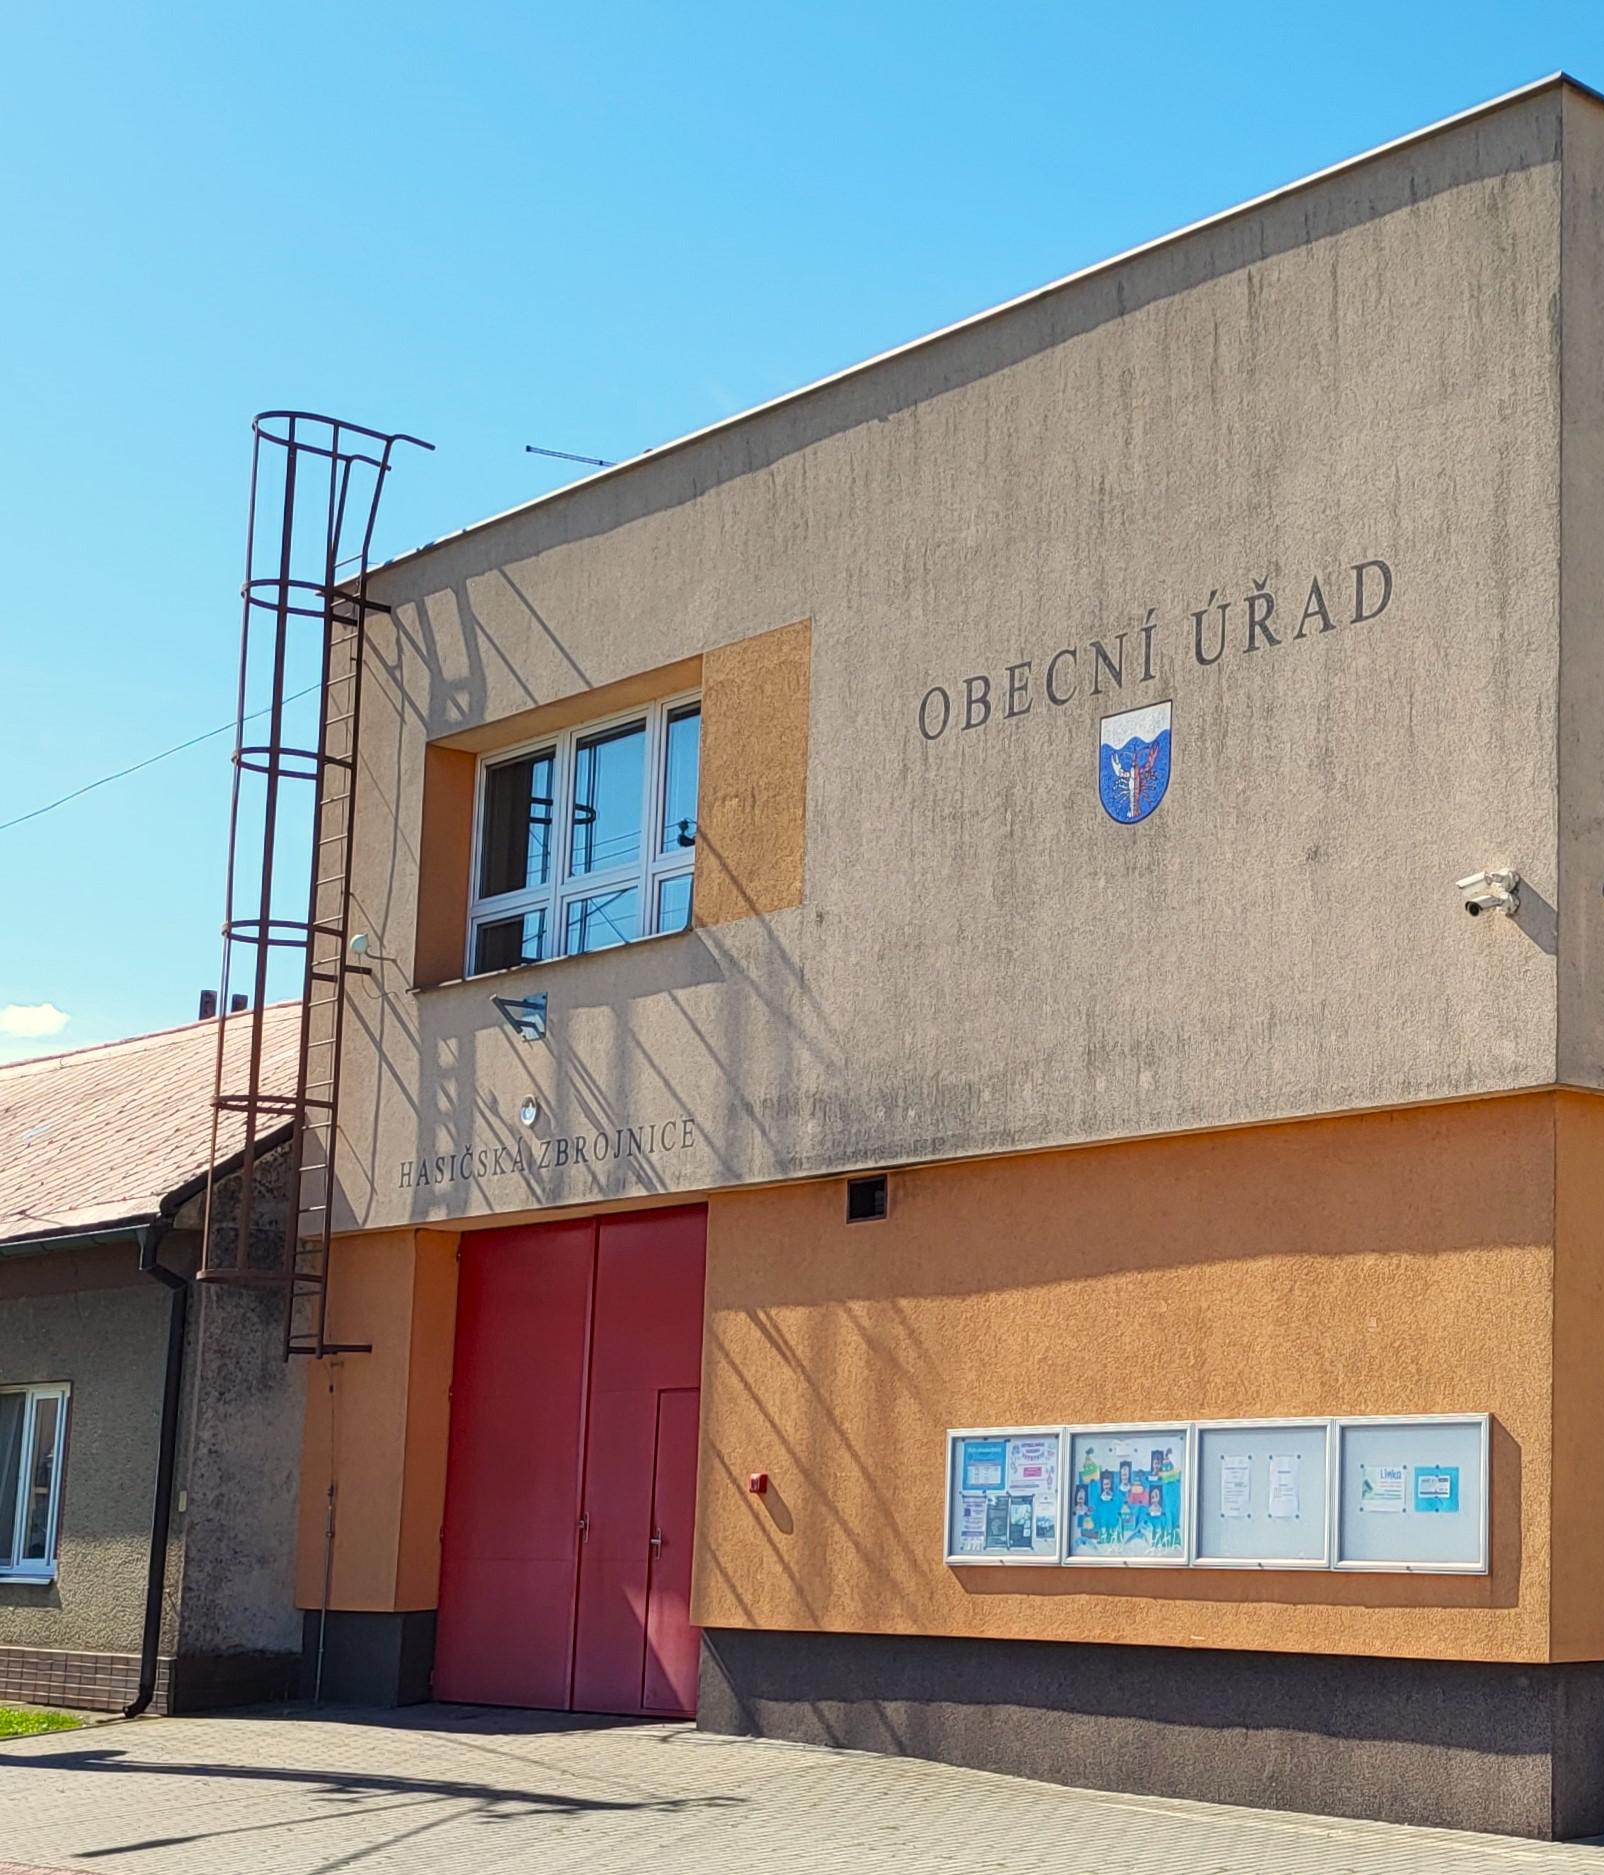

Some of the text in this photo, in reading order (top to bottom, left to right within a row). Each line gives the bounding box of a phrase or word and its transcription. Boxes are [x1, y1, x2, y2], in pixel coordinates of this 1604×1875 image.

[918, 560, 1393, 740] OBECNÍ ÚŘAD
[398, 1118, 697, 1188] HASIČSKÁ ZBROJNICE
